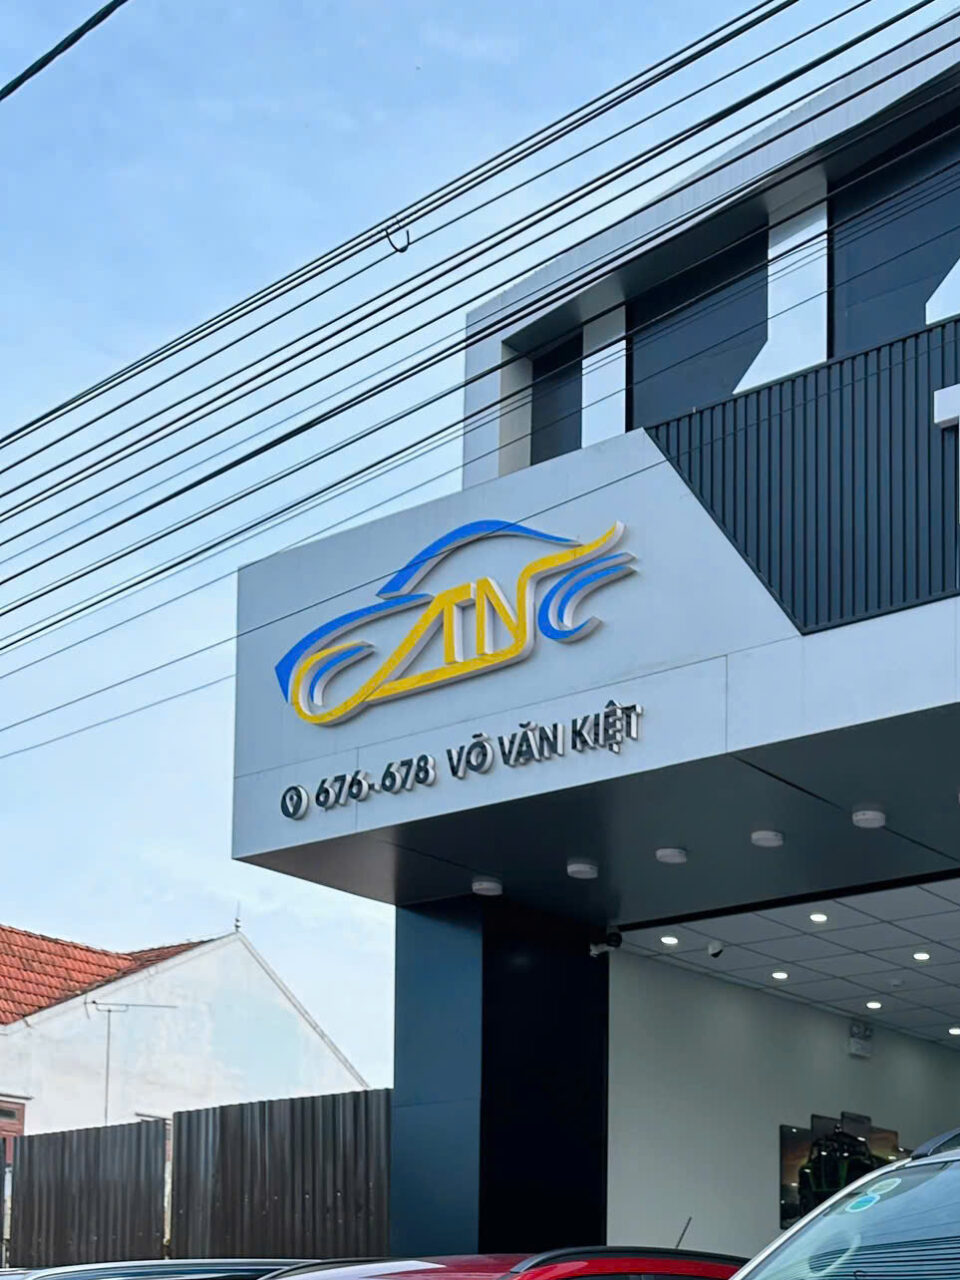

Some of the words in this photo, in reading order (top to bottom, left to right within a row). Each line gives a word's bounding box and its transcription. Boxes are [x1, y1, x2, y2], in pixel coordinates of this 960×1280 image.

[447, 732, 495, 779] VÕ
[498, 721, 565, 768] VĂN
[572, 700, 644, 754] KIỆT
